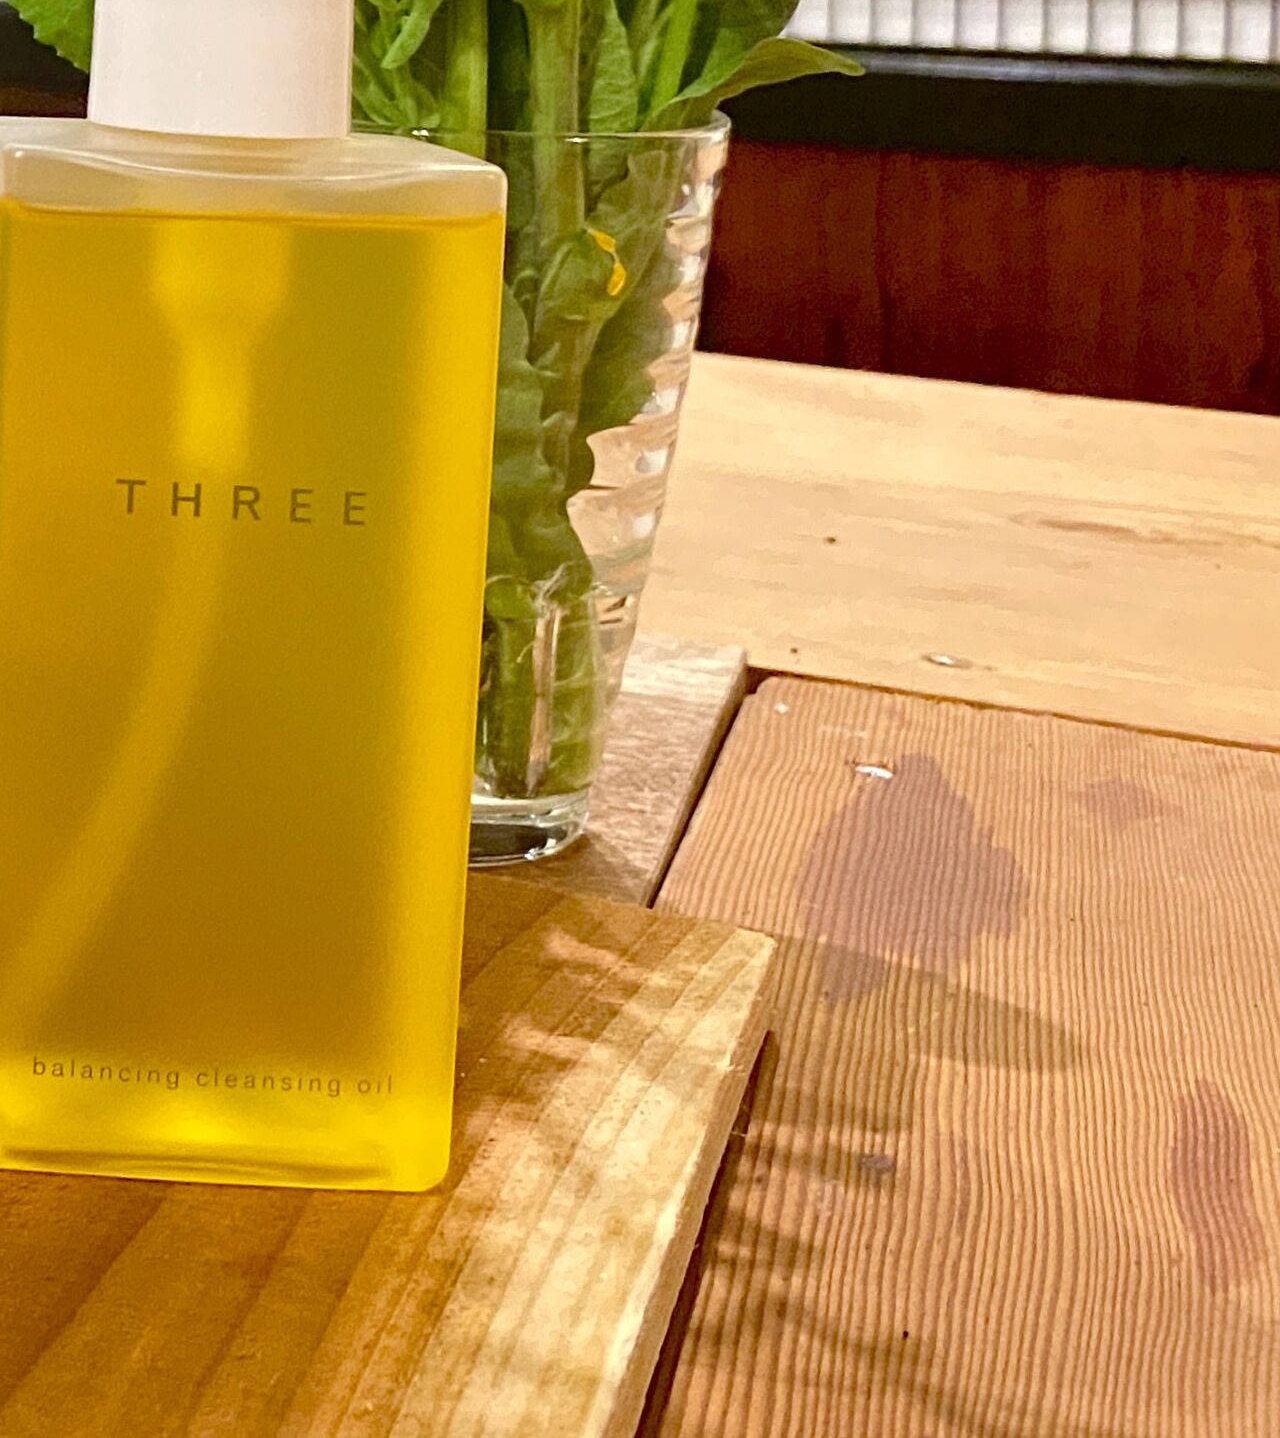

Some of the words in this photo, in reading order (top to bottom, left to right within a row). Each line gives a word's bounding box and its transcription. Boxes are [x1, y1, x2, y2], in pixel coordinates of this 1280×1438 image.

[116, 478, 367, 526] THREE
[32, 1056, 180, 1090] balancing
[196, 1067, 341, 1099] cleansing
[357, 1075, 392, 1096] oil
